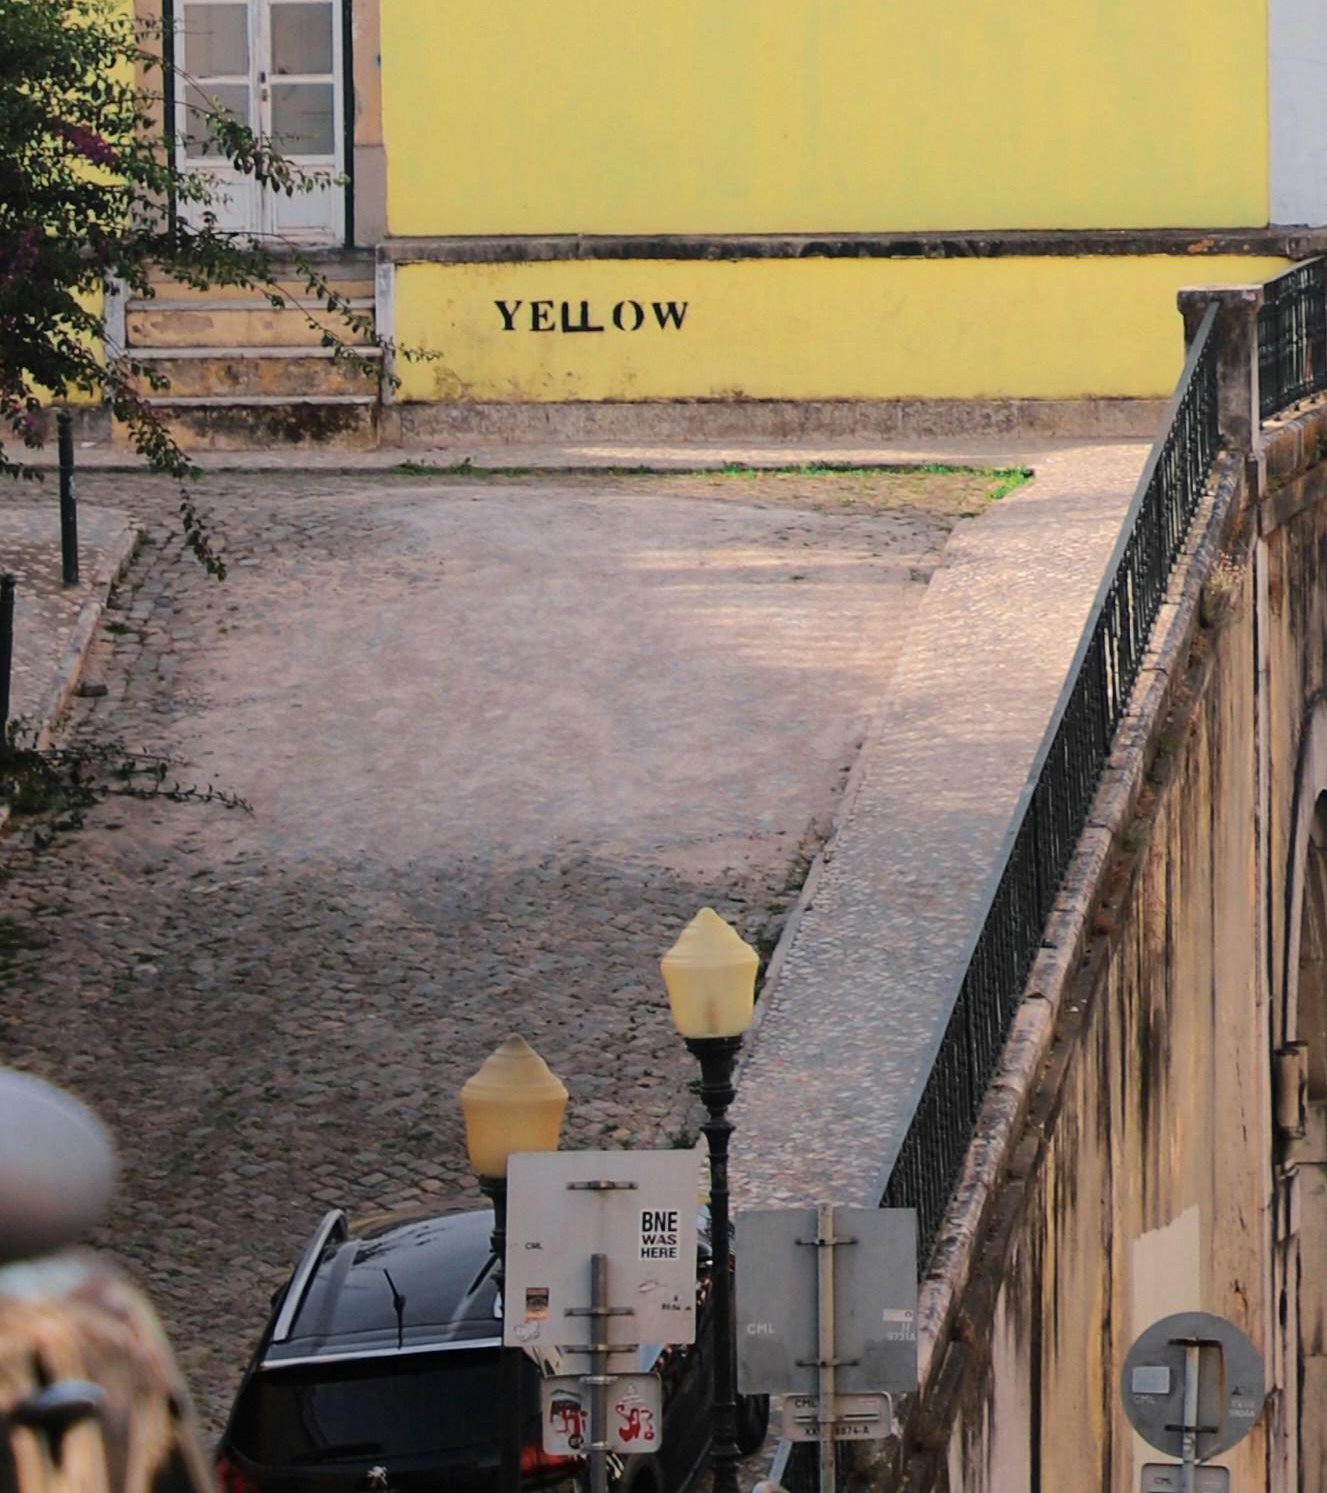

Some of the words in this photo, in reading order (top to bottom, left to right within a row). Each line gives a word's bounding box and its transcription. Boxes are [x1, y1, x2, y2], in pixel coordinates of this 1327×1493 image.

[494, 300, 689, 333] YELLOW
[641, 1211, 678, 1233] BNE
[642, 1234, 677, 1246] WAS
[641, 1247, 677, 1258] HERE
[747, 1323, 775, 1335] CML
[795, 1399, 817, 1408] CML
